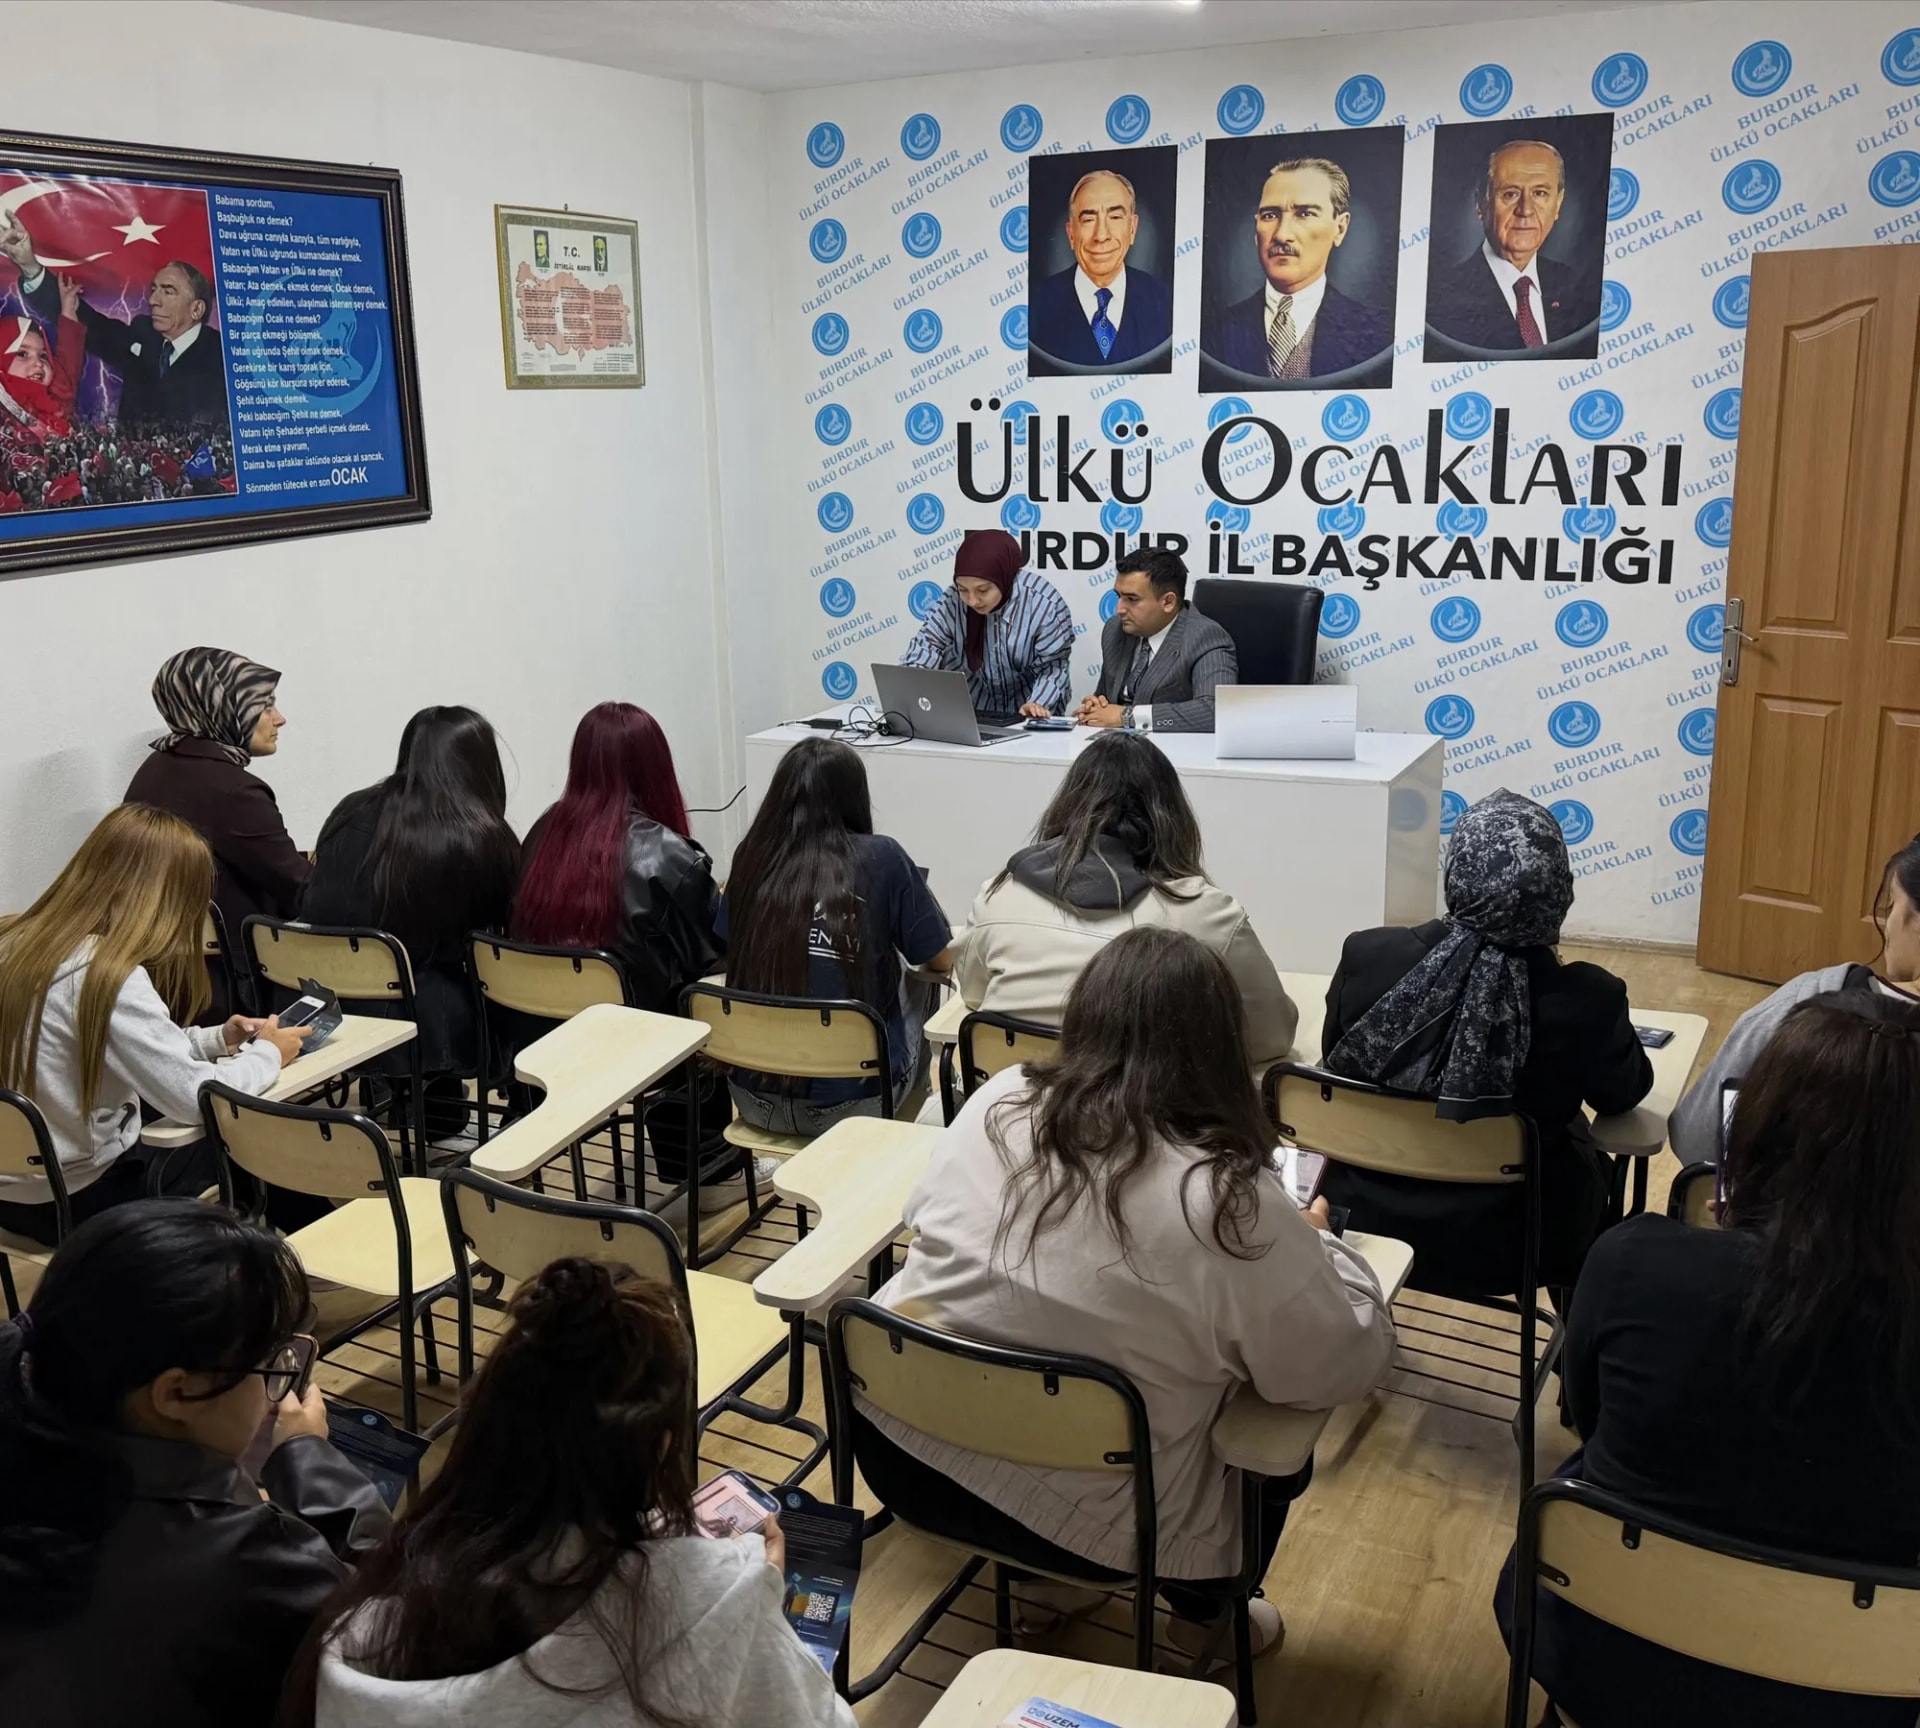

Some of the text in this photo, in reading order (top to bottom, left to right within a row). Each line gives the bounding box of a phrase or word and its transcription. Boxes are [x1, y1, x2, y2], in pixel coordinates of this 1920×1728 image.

[1622, 94, 1713, 146] OCAKLARI
[1709, 83, 1861, 163] ÜLKÜ OCAKLARI
[1737, 83, 1819, 130] BURDUR
[813, 157, 864, 194] BURDUR
[891, 188, 924, 216] ÜLKÜ
[926, 149, 990, 194] OCAKLARI
[907, 150, 960, 188] BURDUR
[216, 195, 275, 210] Babama sordum,
[798, 157, 891, 222] ÜLKÜ OCAKLARI
[219, 228, 236, 240] Dava
[238, 230, 264, 242] uğruna
[317, 235, 330, 244] tüm
[256, 216, 266, 224] ne
[267, 216, 293, 226] demek?
[1614, 209, 1704, 260] OCAKLARI
[1727, 202, 1808, 247] BURDUR
[220, 246, 240, 256] Vatan
[242, 248, 250, 256] ve
[252, 244, 268, 257] Ülkü
[269, 248, 298, 260] uğrunda
[563, 246, 580, 258] T.C.
[1700, 202, 1848, 278] ÜLKÜ OCAKLARI
[260, 264, 280, 274] Vatan
[281, 267, 290, 275] ve
[290, 263, 306, 276] Ülkü
[307, 268, 316, 276] ne
[317, 266, 343, 277] demek?
[816, 254, 866, 289] BURDUR
[893, 249, 990, 310] ÜLKÜ OCAKLARI
[909, 249, 961, 284] BURDUR
[247, 280, 260, 290] Ata
[287, 281, 310, 291] ekmek
[335, 283, 352, 292] Ocak
[801, 254, 892, 314] ÜLKÜ OCAKLARI
[246, 297, 266, 309] Amaç
[353, 300, 364, 310] şey
[265, 313, 284, 324] Ocak
[285, 316, 294, 324] ne
[295, 314, 321, 324] demek?
[229, 330, 240, 340] Bir
[241, 331, 262, 342] parça
[262, 329, 288, 342] ekmeği
[230, 346, 250, 356] Vatan
[267, 362, 278, 372] bir
[819, 347, 868, 380] BURDUR
[910, 345, 961, 379] BURDUR
[1557, 323, 1694, 392] ÜLKÜ OCAKLARI
[308, 378, 326, 388] siper
[804, 348, 894, 404] ÜLKÜ OCAKLARI
[894, 346, 990, 404] ÜLKÜ OCAKLARI
[309, 410, 318, 419] ne
[328, 424, 348, 434] içmek
[242, 444, 263, 454] Merak
[264, 444, 282, 452] etme
[266, 458, 276, 468] bu
[331, 453, 352, 464] olacak
[822, 438, 870, 470] BURDUR
[956, 398, 1153, 505] Ülkü
[309, 480, 318, 488] en
[318, 480, 330, 488] son
[331, 466, 368, 486] OCAK
[808, 440, 895, 492] ÜLKÜ OCAKLARI
[896, 470, 928, 494] ÜLKÜ
[810, 528, 896, 578] ÜLKÜ OCAKLARI
[824, 526, 872, 556] BURDUR
[913, 528, 962, 558] BURDUR
[1208, 521, 1254, 576] İL
[1272, 526, 1675, 591] BAŞKANLIĞI
[898, 558, 928, 582] ÜLKÜ
[812, 615, 898, 662] ÜLKÜ OCAKLARI
[826, 612, 873, 640] BURDUR
[1414, 640, 1539, 694] ÜLKÜ OCAKLARI
[1436, 636, 1504, 669] BURDUR
[1561, 640, 1632, 676] BURDUR
[1536, 644, 1670, 700] ÜLKÜ OCAKLARI
[918, 697, 932, 712] hp
[1452, 738, 1532, 776] OCAKLARI
[1530, 746, 1662, 798] ÜLKÜ OCAKLARI
[1553, 742, 1624, 774] BURDUR
